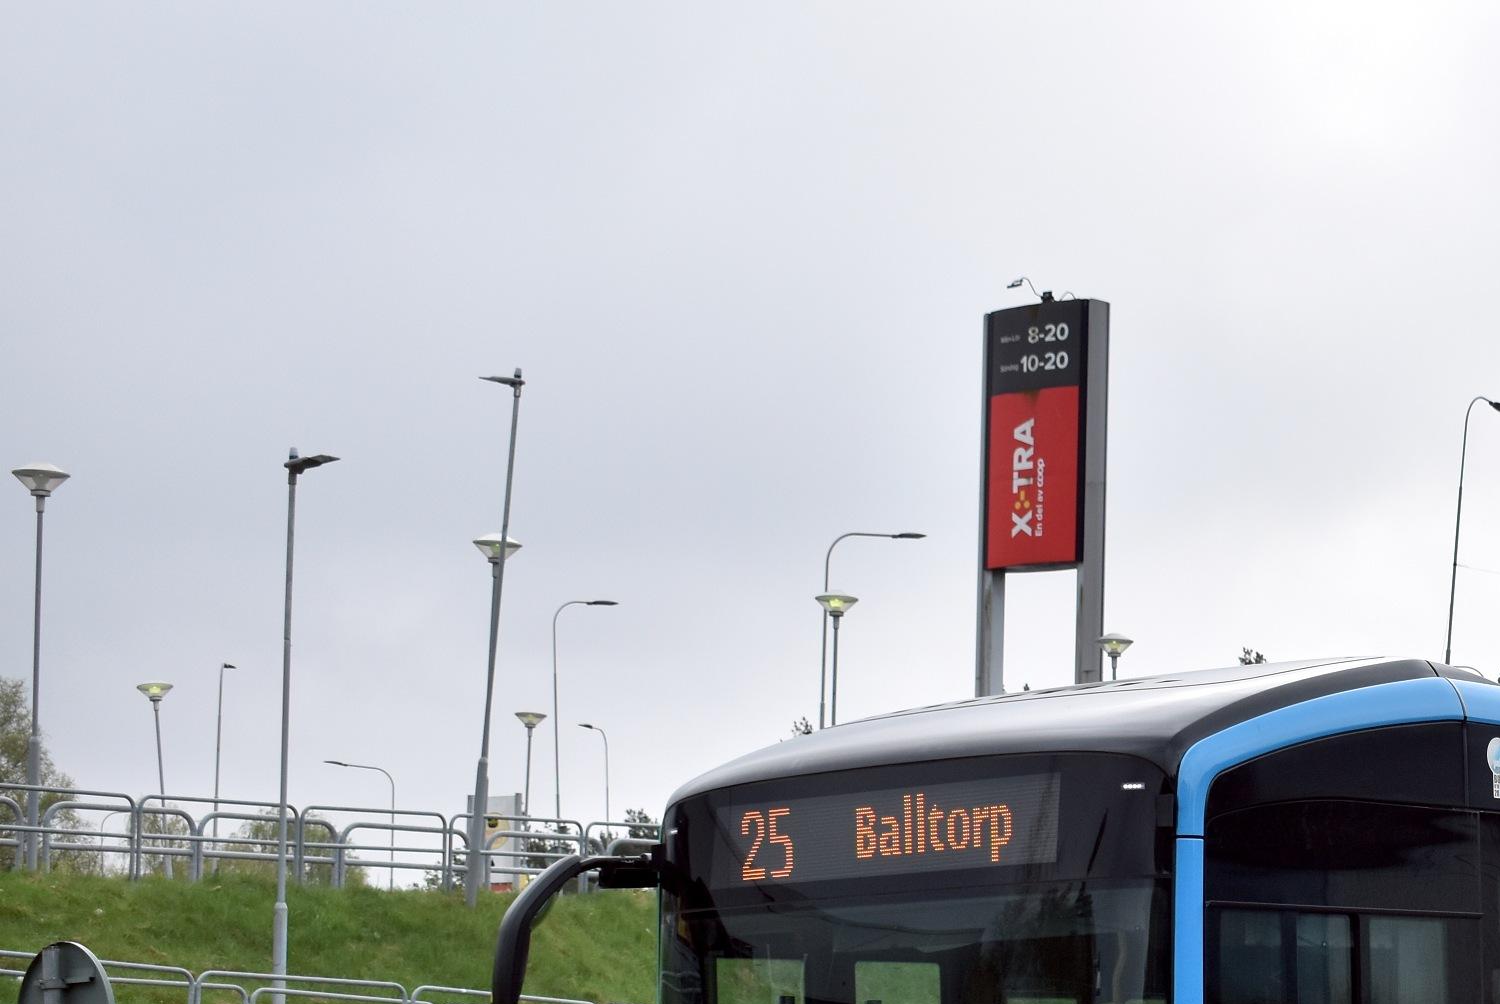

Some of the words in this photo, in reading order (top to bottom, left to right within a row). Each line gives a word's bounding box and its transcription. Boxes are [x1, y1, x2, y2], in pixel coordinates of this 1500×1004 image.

[1028, 322, 1069, 344] 8-20
[1020, 351, 1069, 373] 10-20
[1037, 458, 1046, 487] coop
[1037, 490, 1044, 502] av
[1035, 504, 1044, 521] del
[1035, 523, 1043, 537] En
[741, 807, 793, 881] 25
[856, 792, 1012, 862] Balltorp
